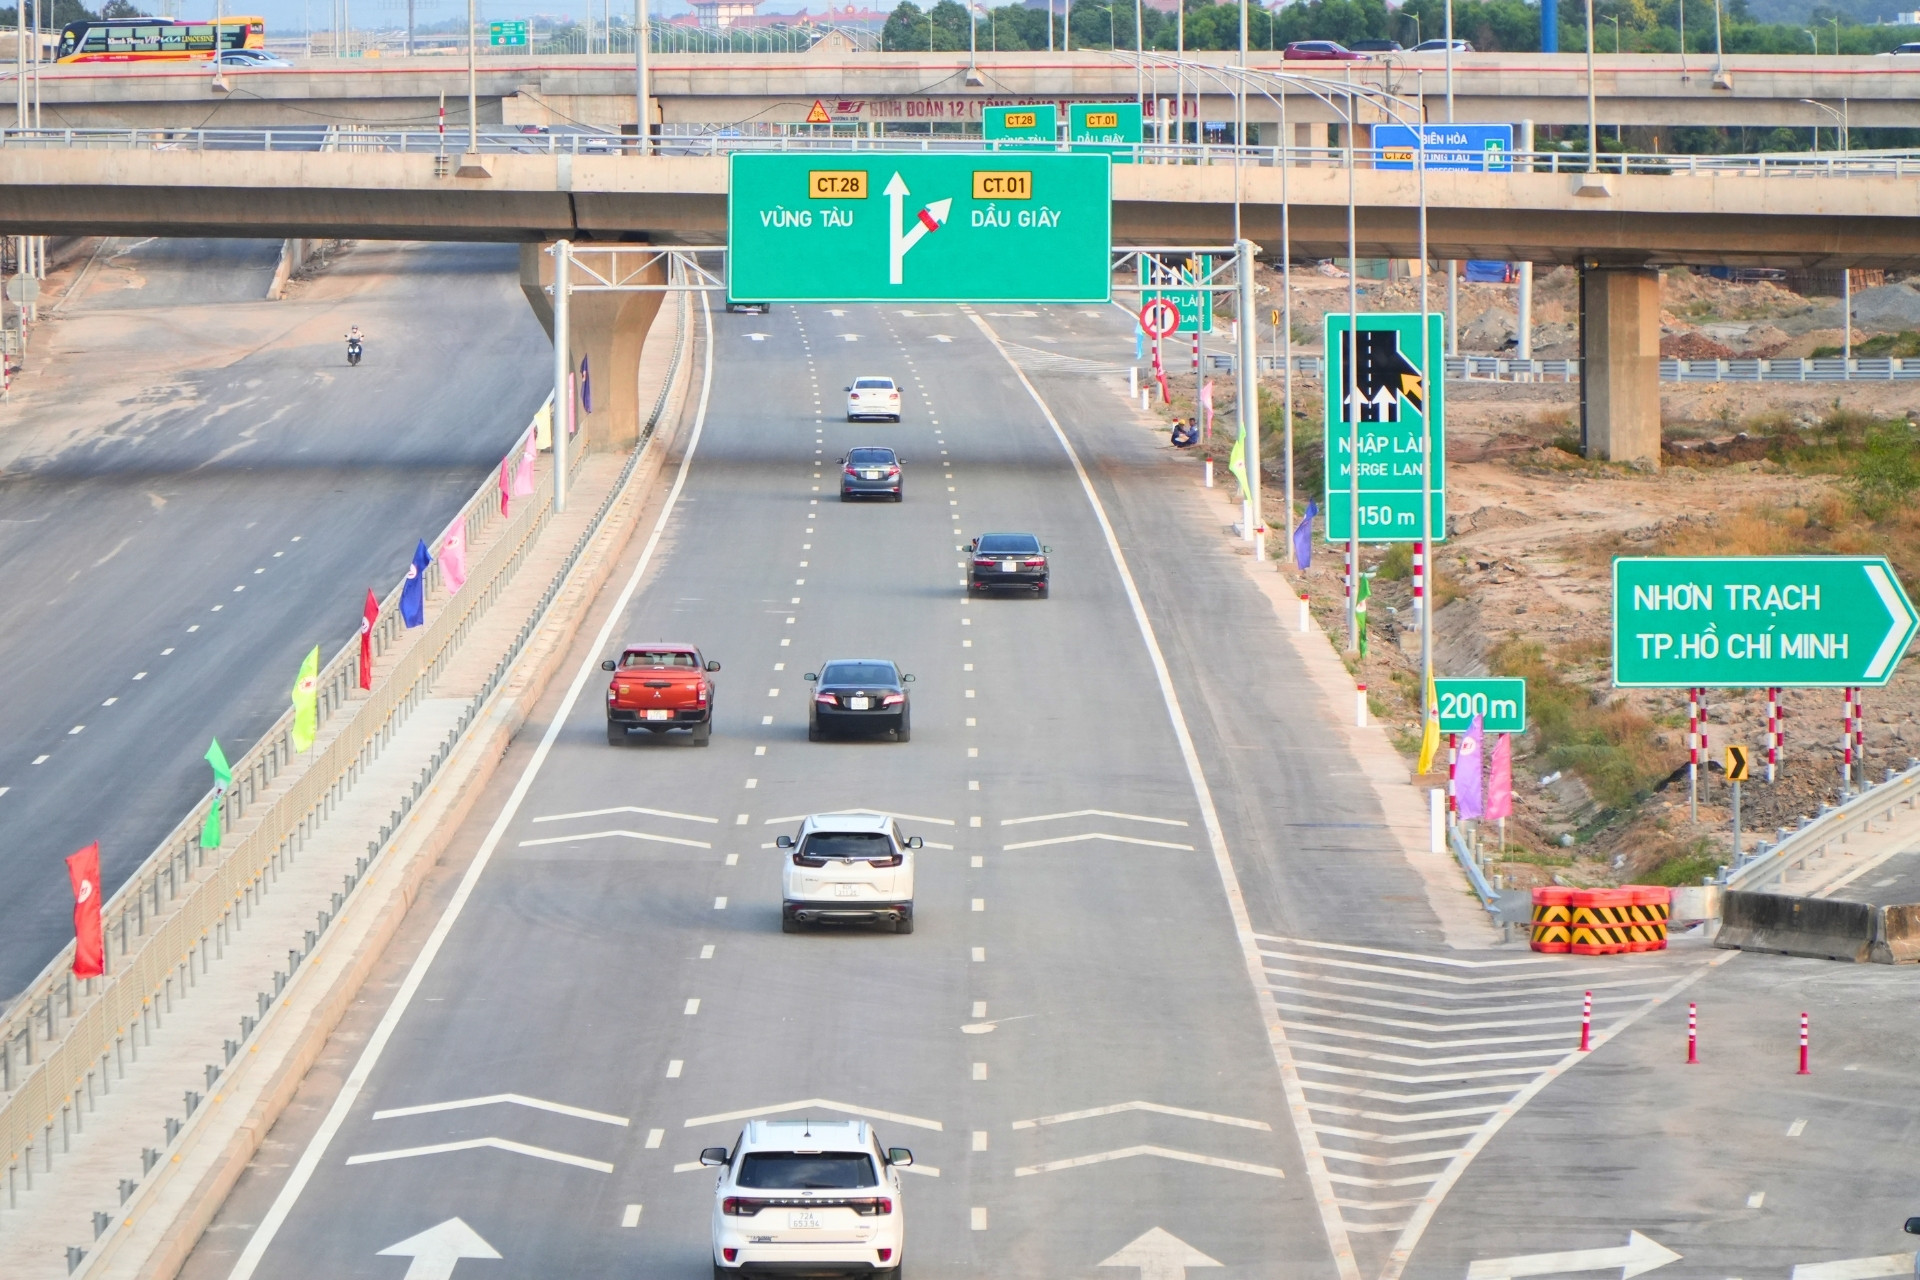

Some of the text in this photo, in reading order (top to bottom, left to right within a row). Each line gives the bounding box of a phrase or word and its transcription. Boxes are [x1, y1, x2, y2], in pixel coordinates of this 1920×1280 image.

[144, 35, 160, 44] VIP
[182, 35, 214, 43] LIMOUSINE
[907, 97, 943, 117] ĐOÀN
[948, 101, 964, 116] 12
[1007, 115, 1033, 125] CT.28
[1089, 115, 1115, 125] CT.01
[1422, 131, 1468, 145] BIÊN HÒA
[817, 177, 859, 193] CT.28
[983, 177, 1024, 193] CT.01
[759, 204, 854, 228] VŨNG TÀU
[971, 202, 1062, 228] DẦU GIÂY
[1338, 432, 1389, 456] NHẬP
[1340, 463, 1426, 476] MERGE LAN
[1358, 505, 1415, 526] 150 m
[1633, 581, 1820, 617] NHƠN TRẠCH
[1636, 622, 1849, 660] TP.HỒ CHÍ MINH
